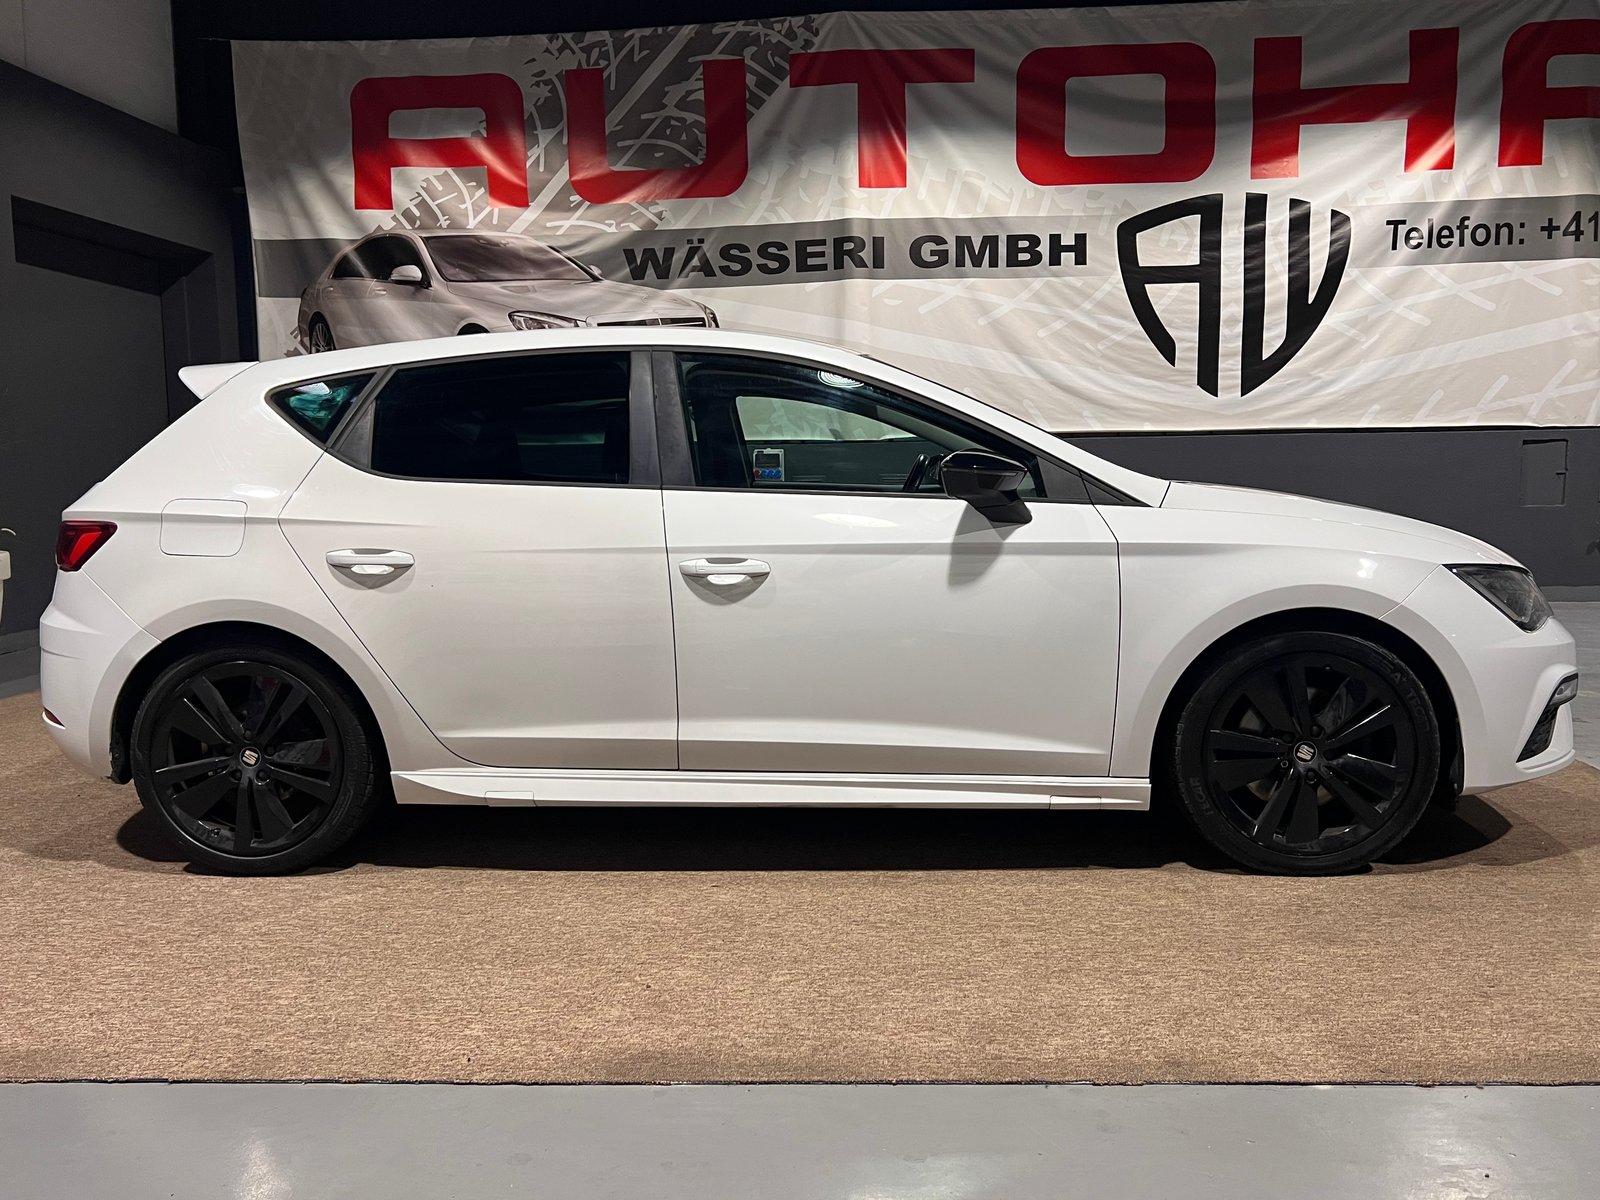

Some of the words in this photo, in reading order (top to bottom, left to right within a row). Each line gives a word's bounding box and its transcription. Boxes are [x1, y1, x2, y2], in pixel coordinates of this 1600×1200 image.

[1386, 216, 1526, 251] Telefon:
[1540, 211, 1599, 242] +41
[622, 236, 886, 281] WÄSSERI
[909, 233, 1087, 269] GMBH
